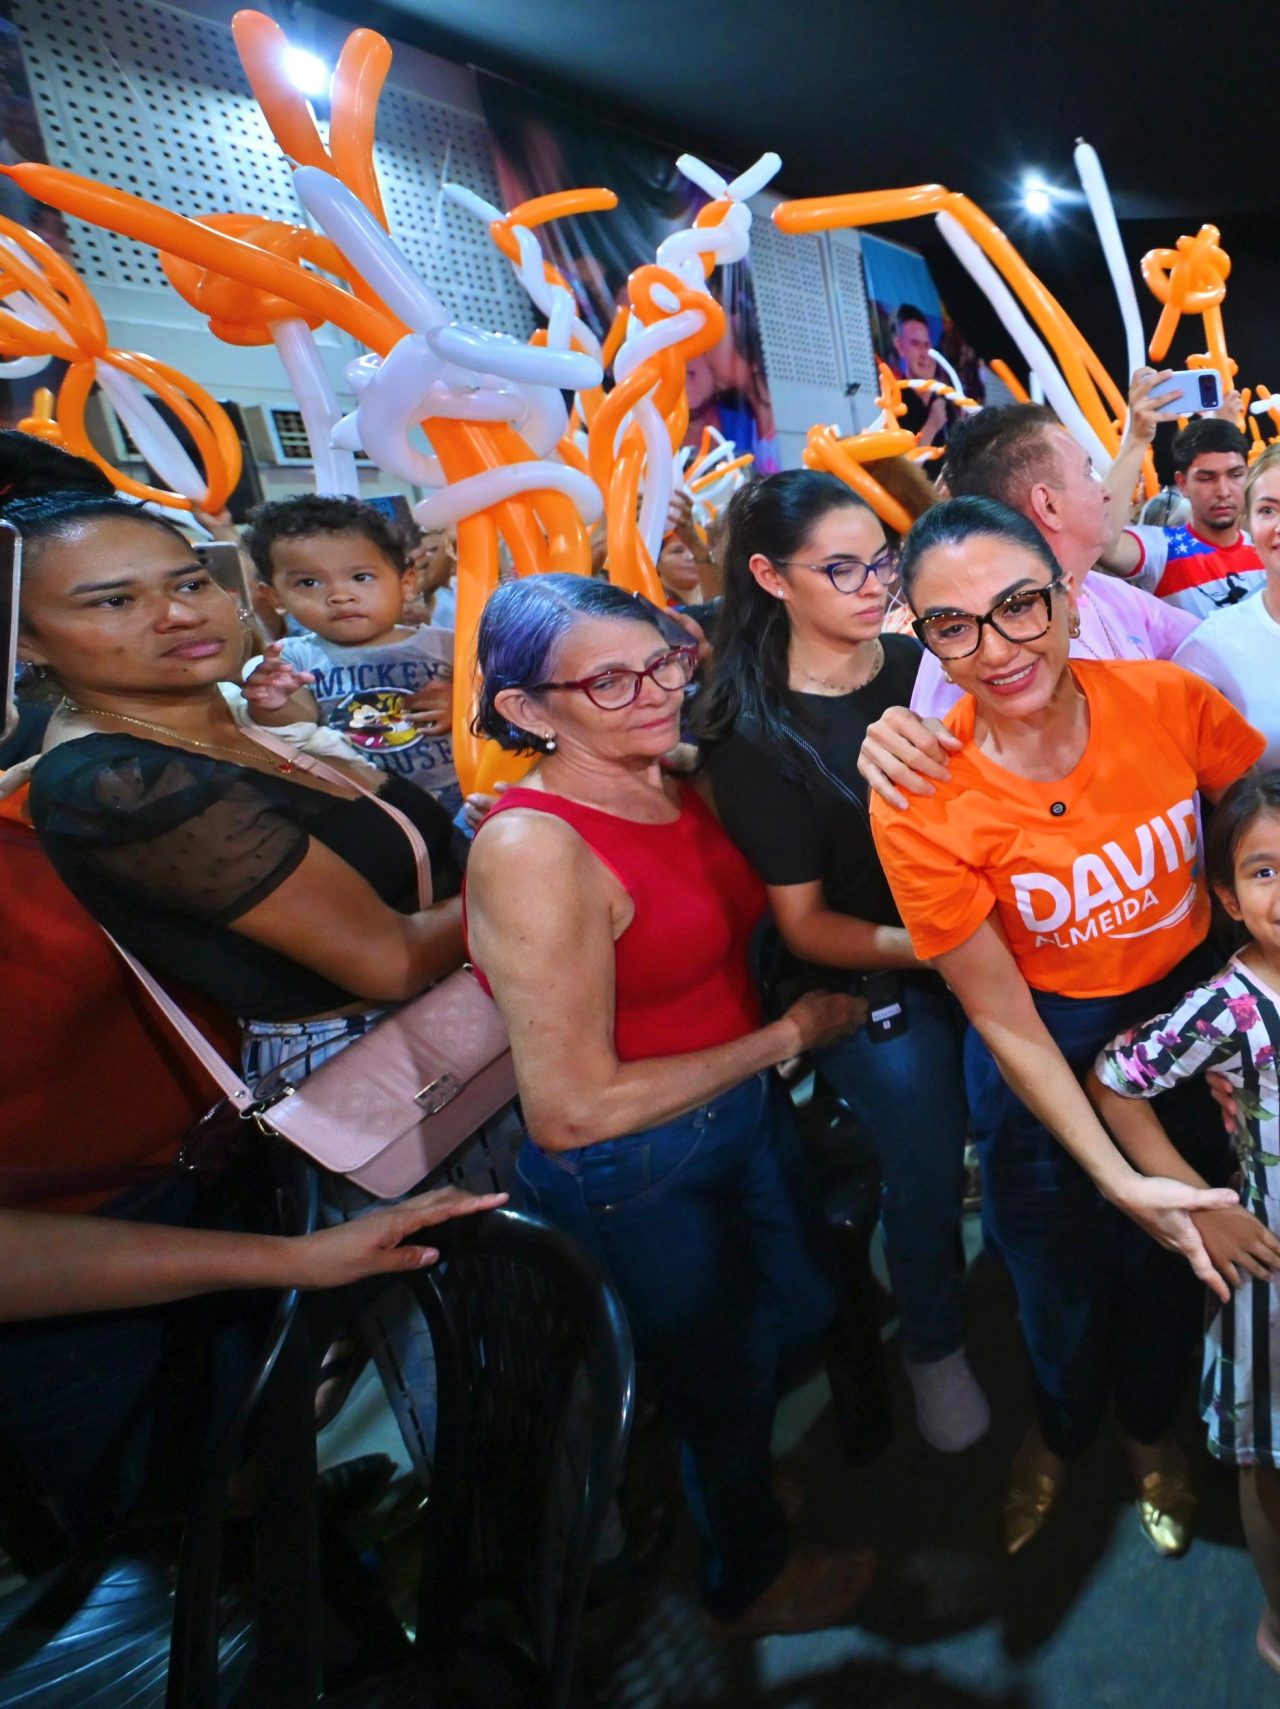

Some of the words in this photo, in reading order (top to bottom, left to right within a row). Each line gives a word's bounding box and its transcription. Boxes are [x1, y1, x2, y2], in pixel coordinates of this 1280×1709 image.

[312, 661, 440, 698] MICKEY
[362, 739, 454, 774] OUSE
[1010, 799, 1198, 933] DAVID
[1034, 888, 1159, 949] ALMEIDA
